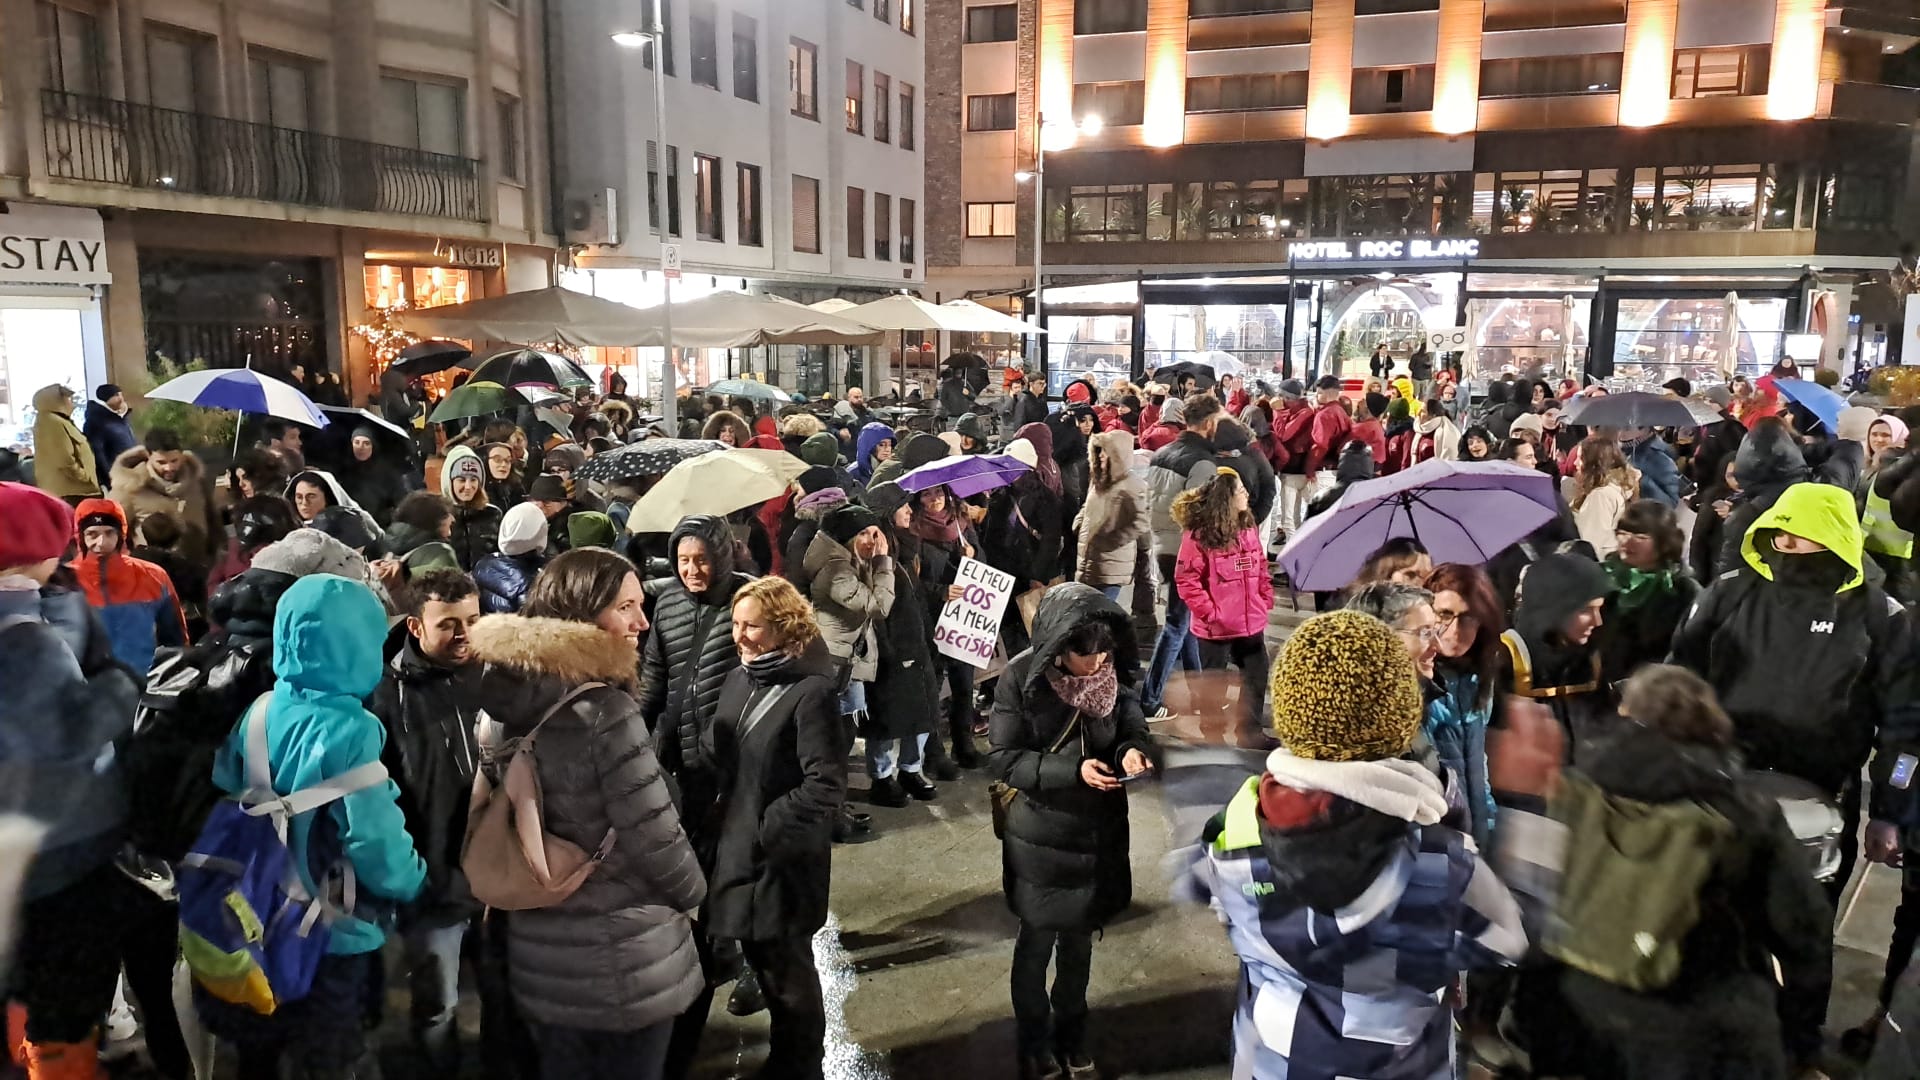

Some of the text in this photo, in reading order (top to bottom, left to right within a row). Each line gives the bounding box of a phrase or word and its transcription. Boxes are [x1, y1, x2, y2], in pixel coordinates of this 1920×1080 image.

[1, 236, 100, 272] STAY
[1289, 239, 1479, 258] HOTEL ROC BLANC
[962, 560, 1010, 593] EL MEU
[963, 584, 996, 610] COS
[944, 602, 997, 636] LA MEVA
[1810, 620, 1834, 634] HH
